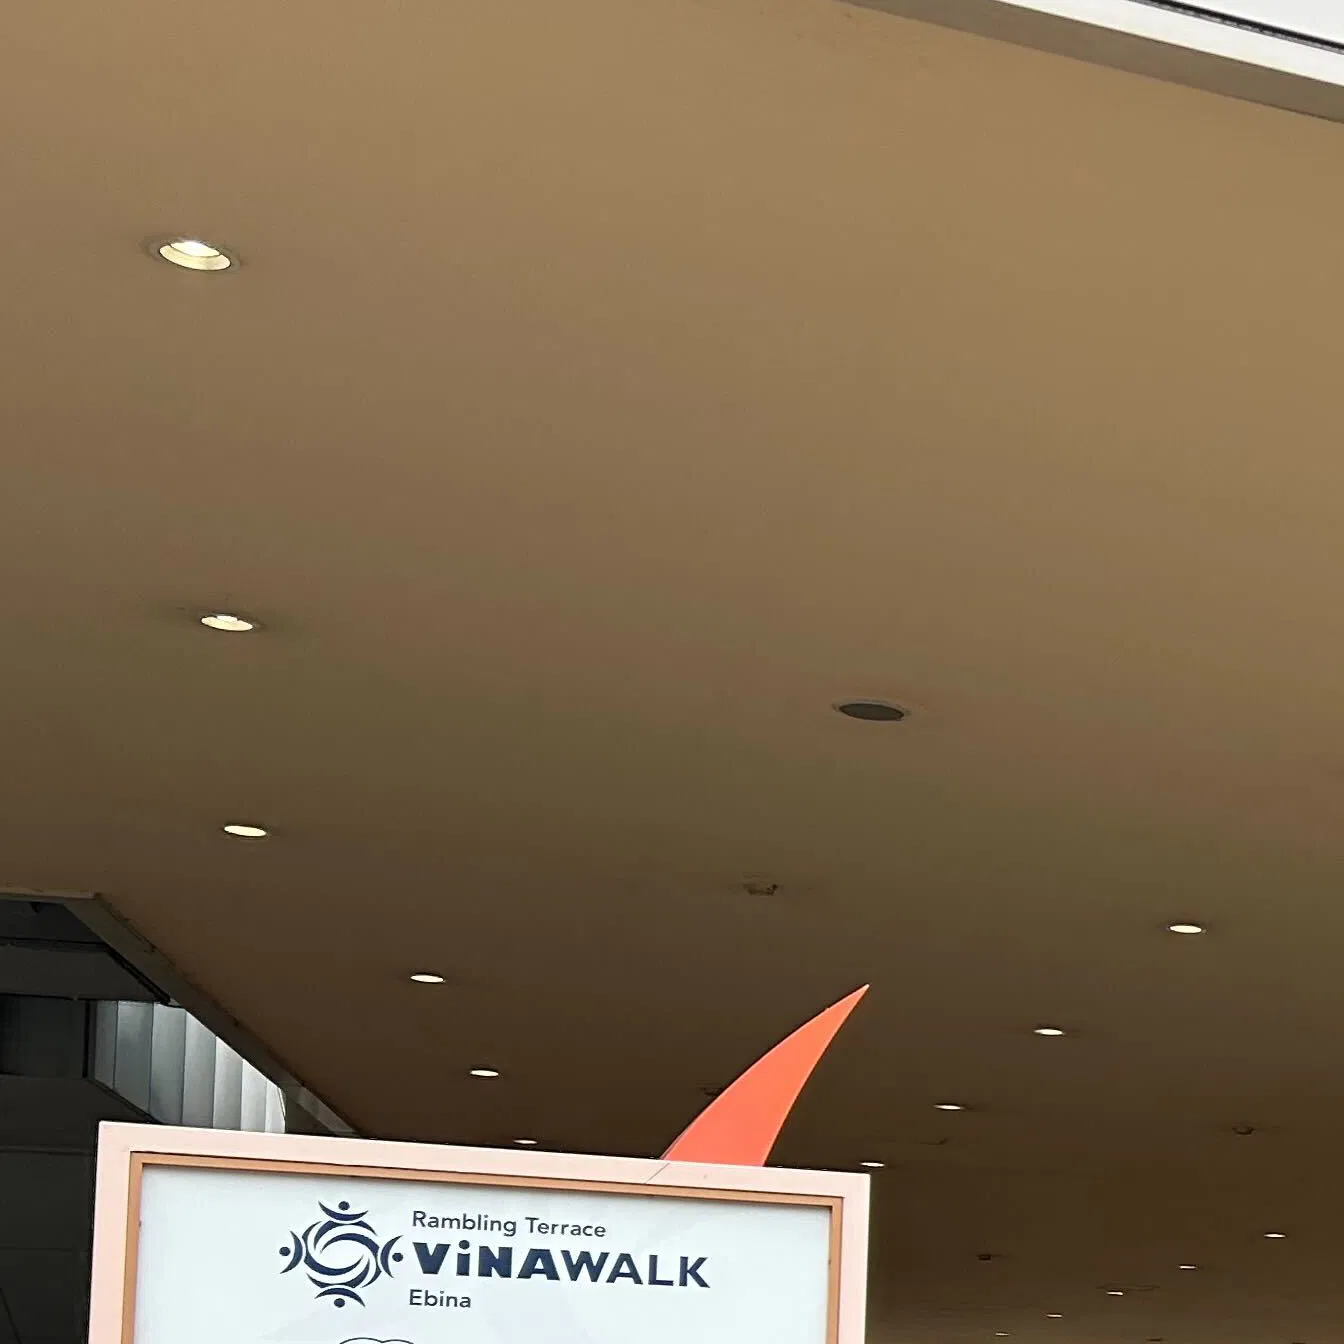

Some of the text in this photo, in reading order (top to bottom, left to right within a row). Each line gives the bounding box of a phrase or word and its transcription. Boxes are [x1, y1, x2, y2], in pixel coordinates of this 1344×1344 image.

[412, 1210, 606, 1238] Rambling Terrace
[409, 1288, 472, 1309] Ebina
